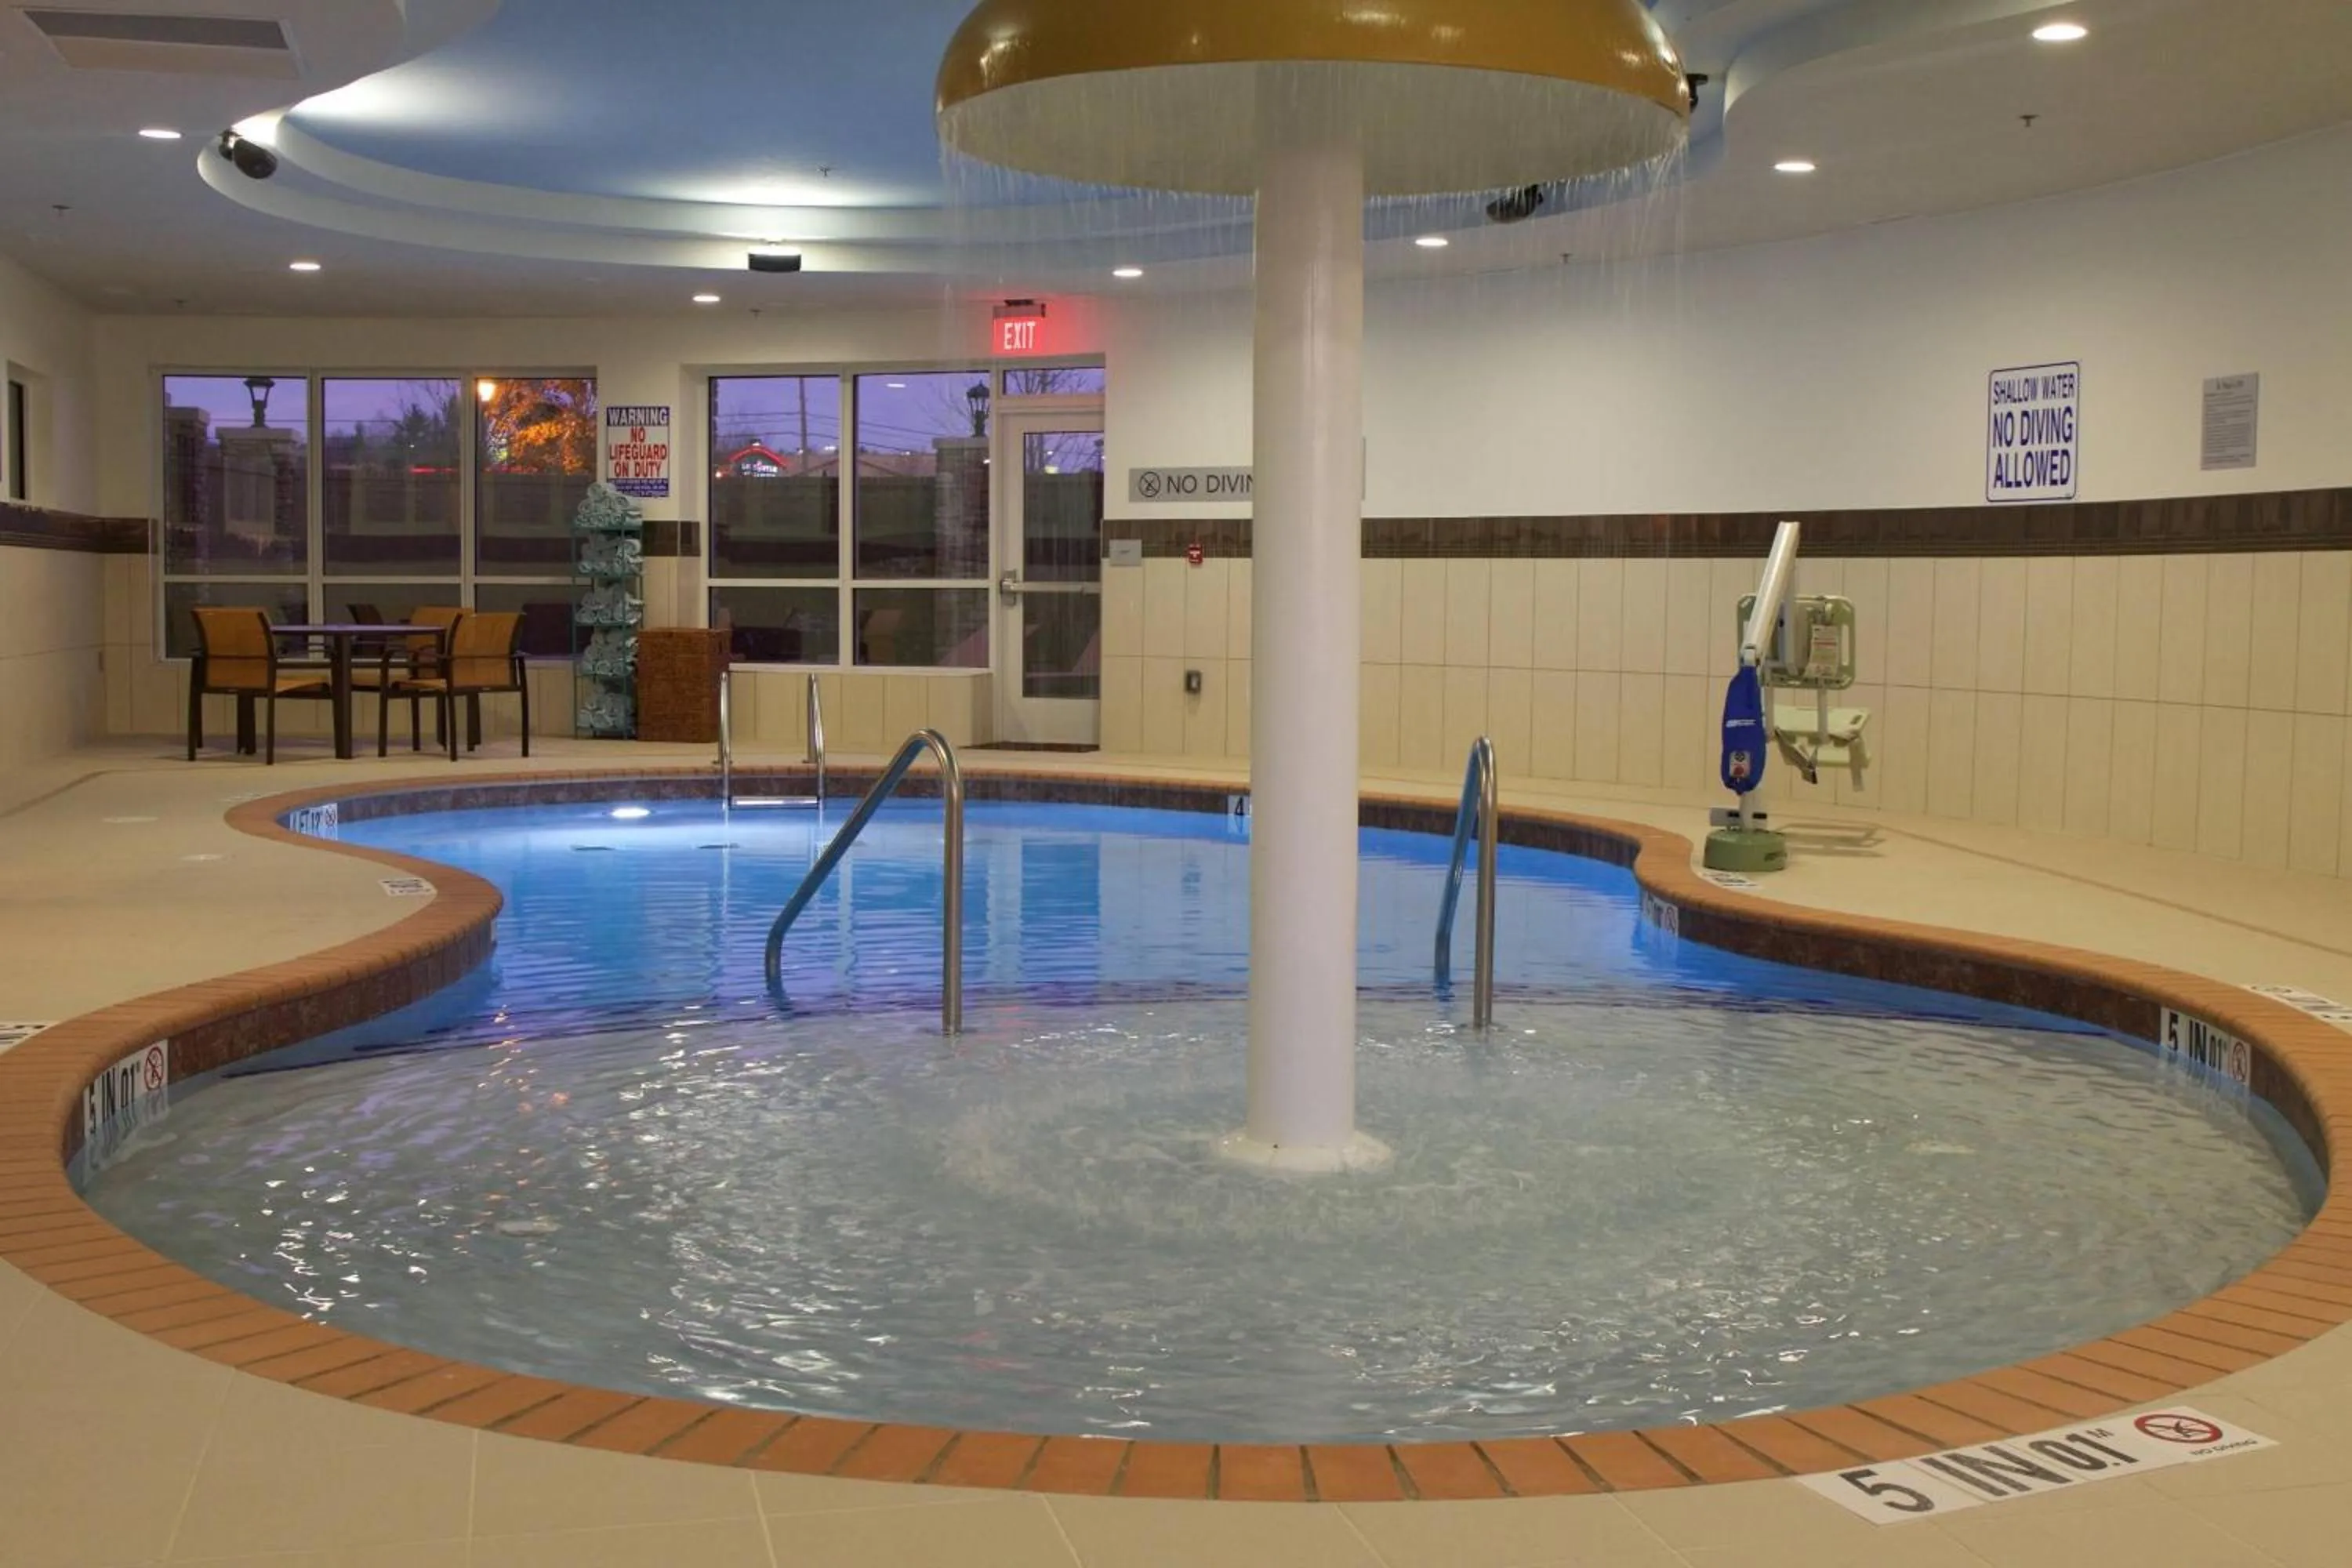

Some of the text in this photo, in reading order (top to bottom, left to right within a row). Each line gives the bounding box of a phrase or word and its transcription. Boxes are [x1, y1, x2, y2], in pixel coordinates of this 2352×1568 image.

[1004, 321, 1036, 350] EXIT
[1994, 373, 2075, 405] SHALLOW WATER
[608, 408, 667, 426] WARNING
[1993, 406, 2073, 448] NO DIVING
[630, 426, 646, 442] NO
[609, 444, 667, 459] LIFEGUARD
[615, 462, 662, 477] ON DUTY
[1167, 474, 1197, 493] NO
[1994, 449, 2071, 488] ALLOWED
[2168, 1011, 2179, 1051] 5
[2189, 1019, 2207, 1062] IN
[101, 1065, 116, 1123] IN
[1838, 1468, 1935, 1512] 5
[1919, 1445, 2073, 1497] IN
